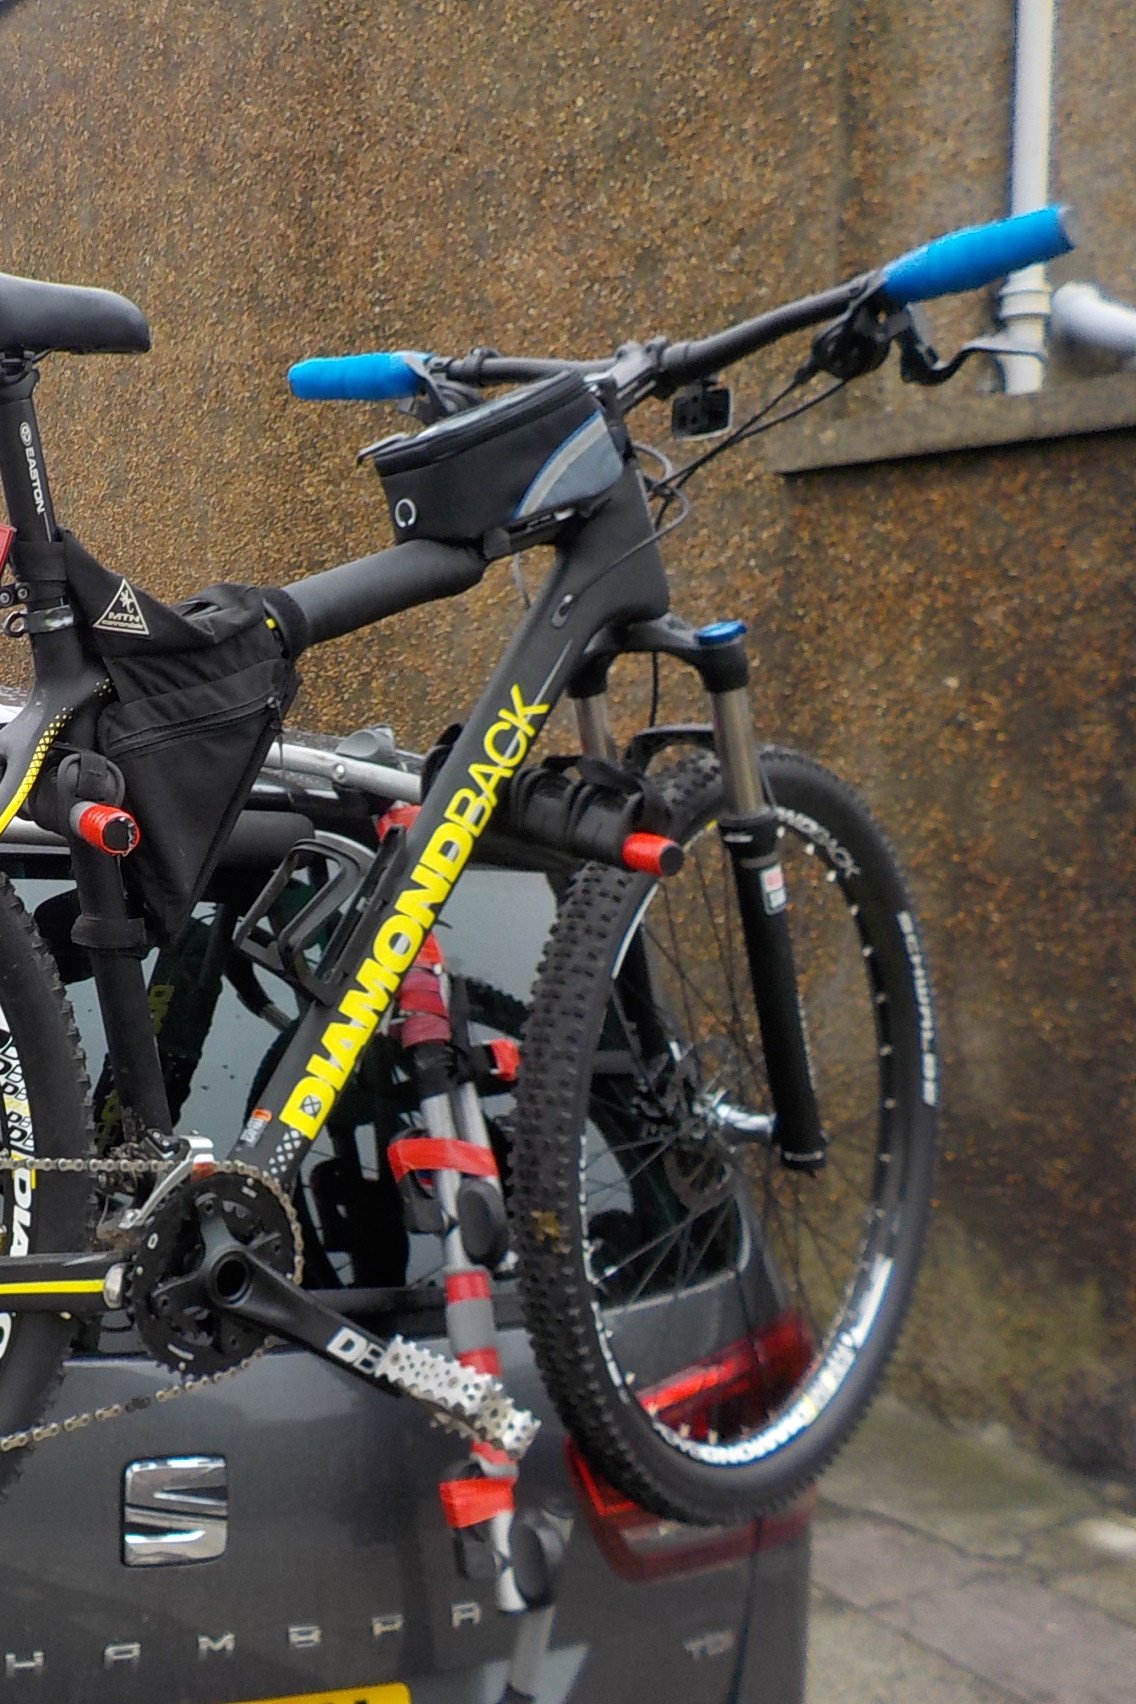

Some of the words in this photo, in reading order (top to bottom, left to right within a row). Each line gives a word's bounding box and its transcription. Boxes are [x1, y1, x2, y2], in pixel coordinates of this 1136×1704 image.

[25, 446, 46, 515] EASTON
[108, 611, 140, 623] MTN
[280, 684, 550, 1140] DIAMONDBACK
